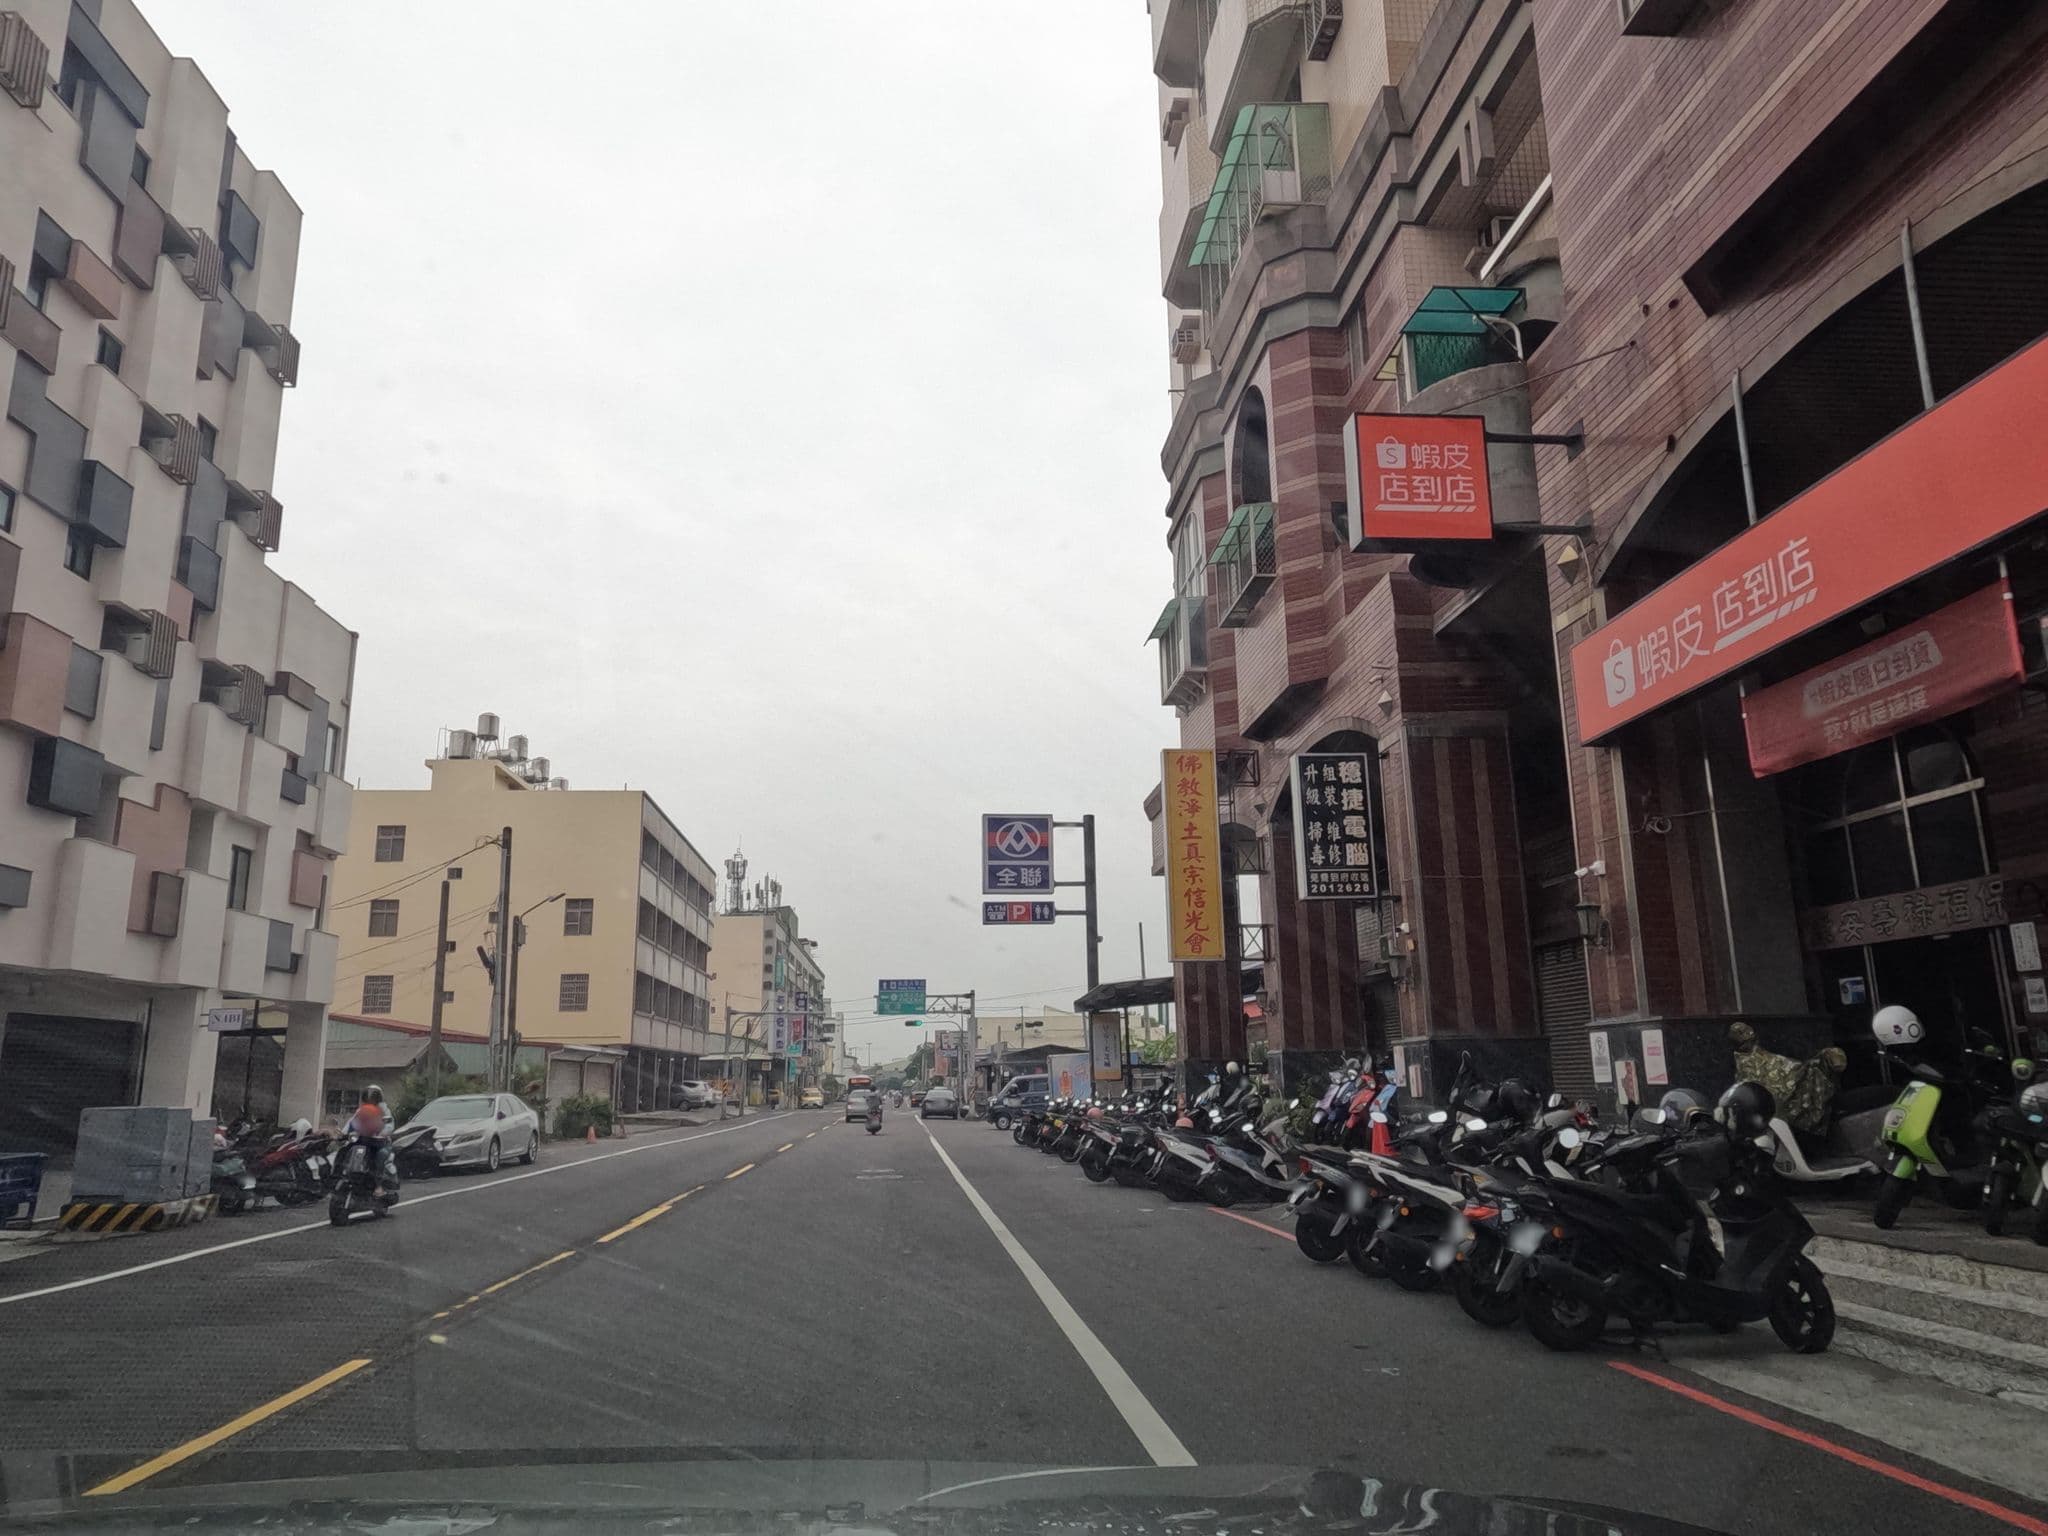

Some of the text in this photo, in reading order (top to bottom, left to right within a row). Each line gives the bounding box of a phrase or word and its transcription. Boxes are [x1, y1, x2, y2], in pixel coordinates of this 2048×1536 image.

[1411, 443, 1472, 470] 蝦皮
[1379, 472, 1475, 503] 店到店
[1712, 536, 1815, 634] 店到店
[1637, 603, 1710, 690] 蝦皮
[1337, 760, 1370, 866] 穩捷電腦
[996, 867, 1042, 887] 全聯
[1012, 904, 1026, 920] P
